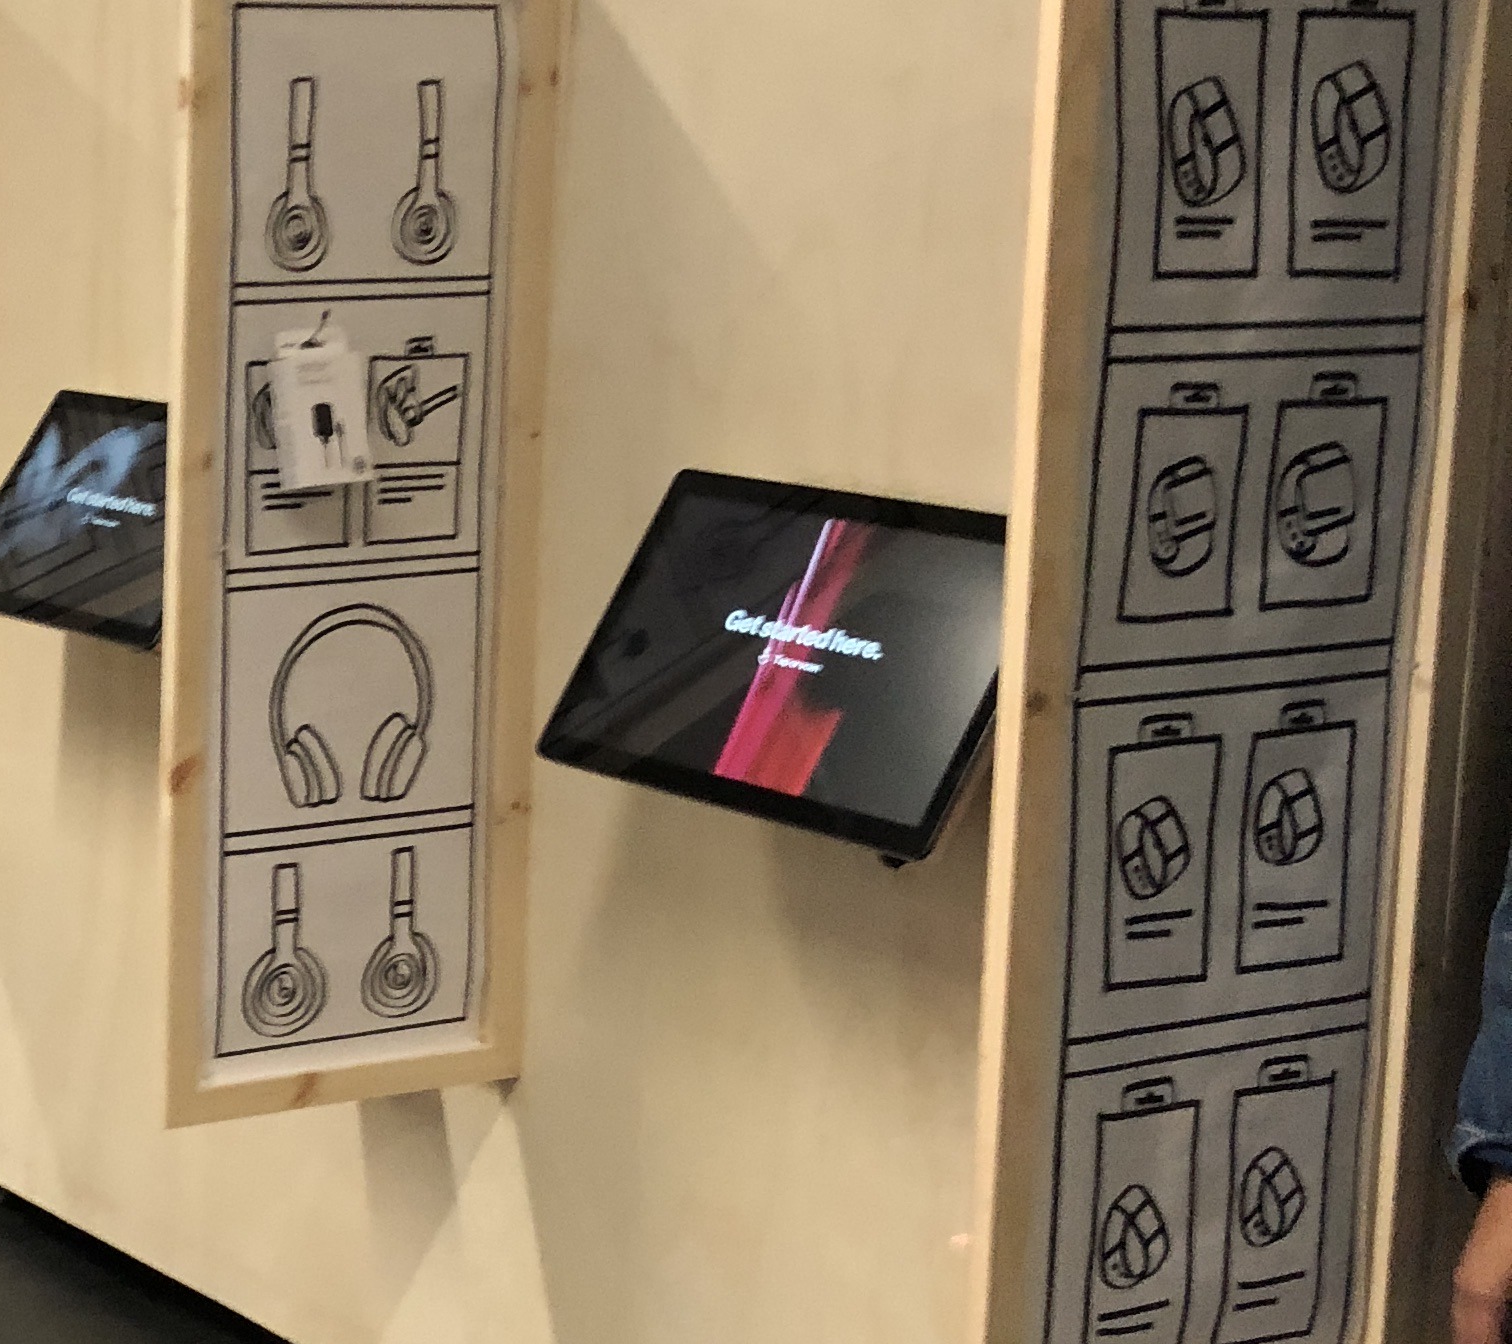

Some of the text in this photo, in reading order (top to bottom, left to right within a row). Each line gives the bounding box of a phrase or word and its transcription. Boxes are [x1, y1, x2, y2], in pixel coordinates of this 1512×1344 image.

[724, 609, 886, 661] Get started here.
